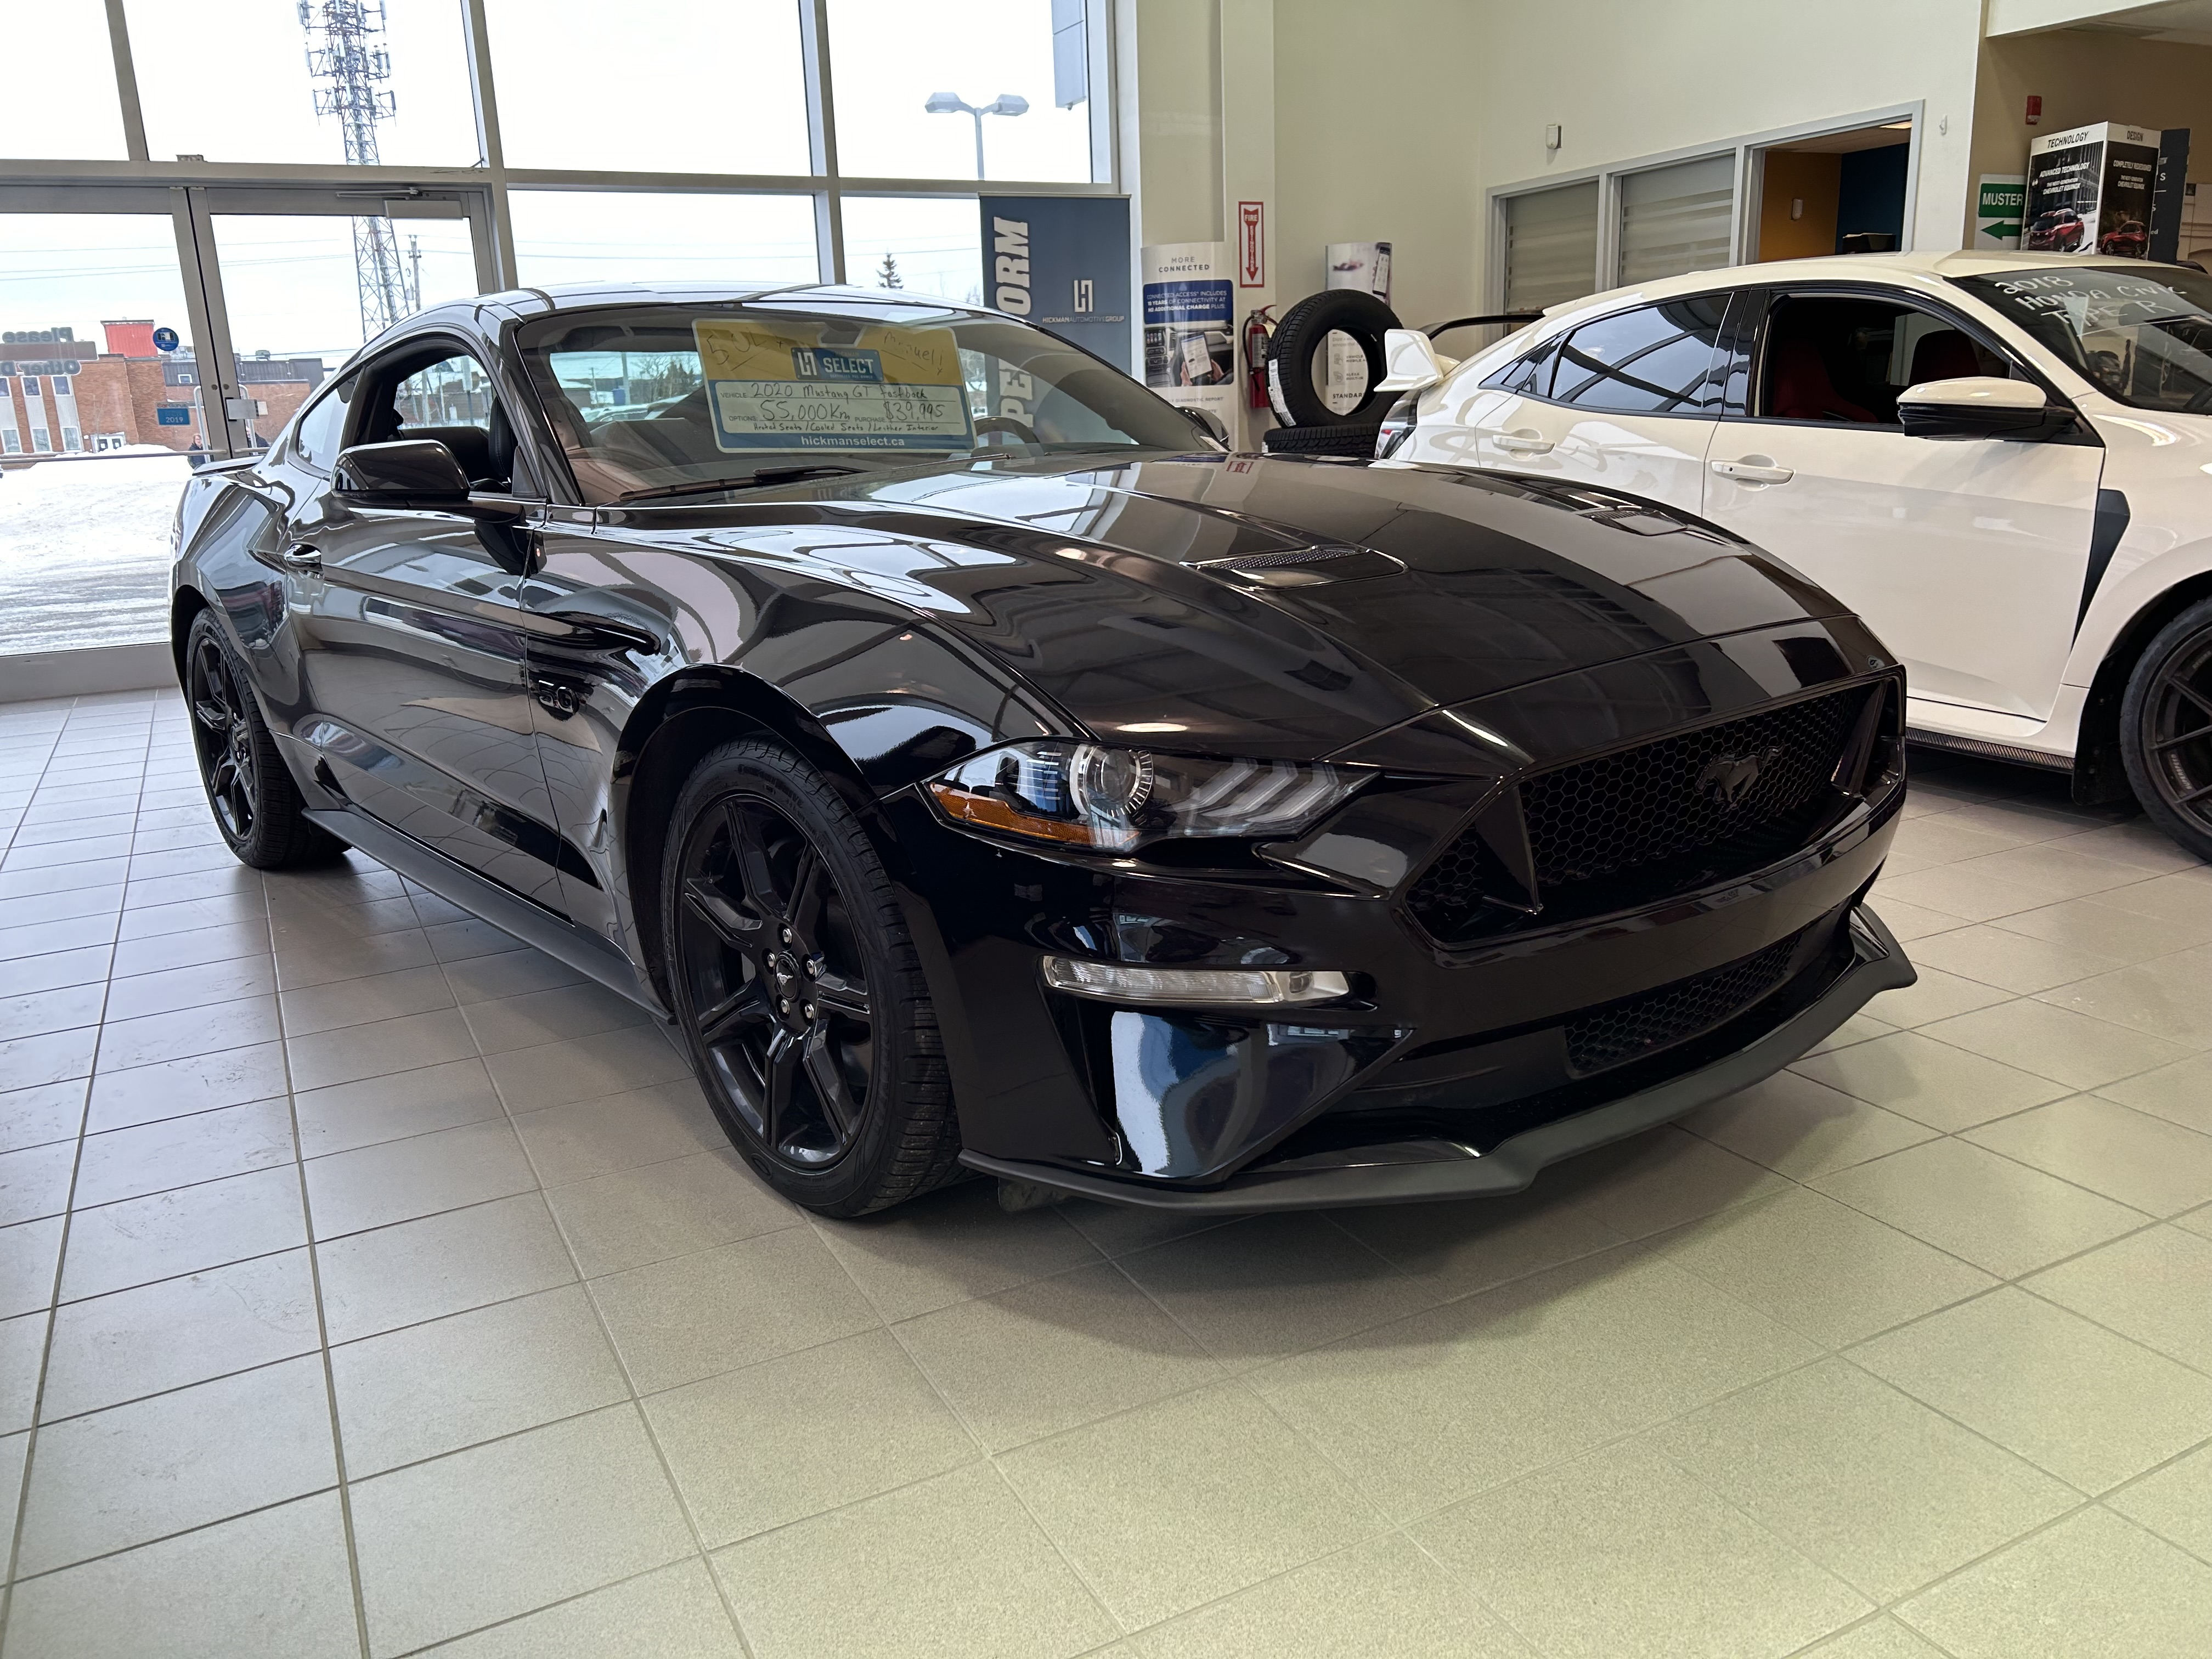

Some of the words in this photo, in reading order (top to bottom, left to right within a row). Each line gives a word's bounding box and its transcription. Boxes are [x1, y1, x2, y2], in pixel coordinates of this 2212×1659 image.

[2047, 131, 2089, 149] TECHNOLOGY
[2127, 131, 2143, 142] DESIGN
[2039, 167, 2062, 178] ADVANCED
[2061, 162, 2090, 173] TECHNOLOGY
[2113, 160, 2134, 168] COMPLETELY
[2042, 185, 2064, 195] CHEVROLET
[1982, 193, 2023, 206] MUSTER
[1159, 264, 1210, 273] CONNECTED
[1995, 276, 2074, 294] 2018
[2015, 289, 2111, 311] HONDA
[2135, 300, 2176, 313] R
[823, 357, 873, 373] SELECT
[751, 382, 793, 397] 2020
[803, 385, 849, 404] Mustang
[853, 385, 872, 398] GT
[883, 400, 945, 424] $39,995
[802, 436, 905, 446] hickmanselect.ca
